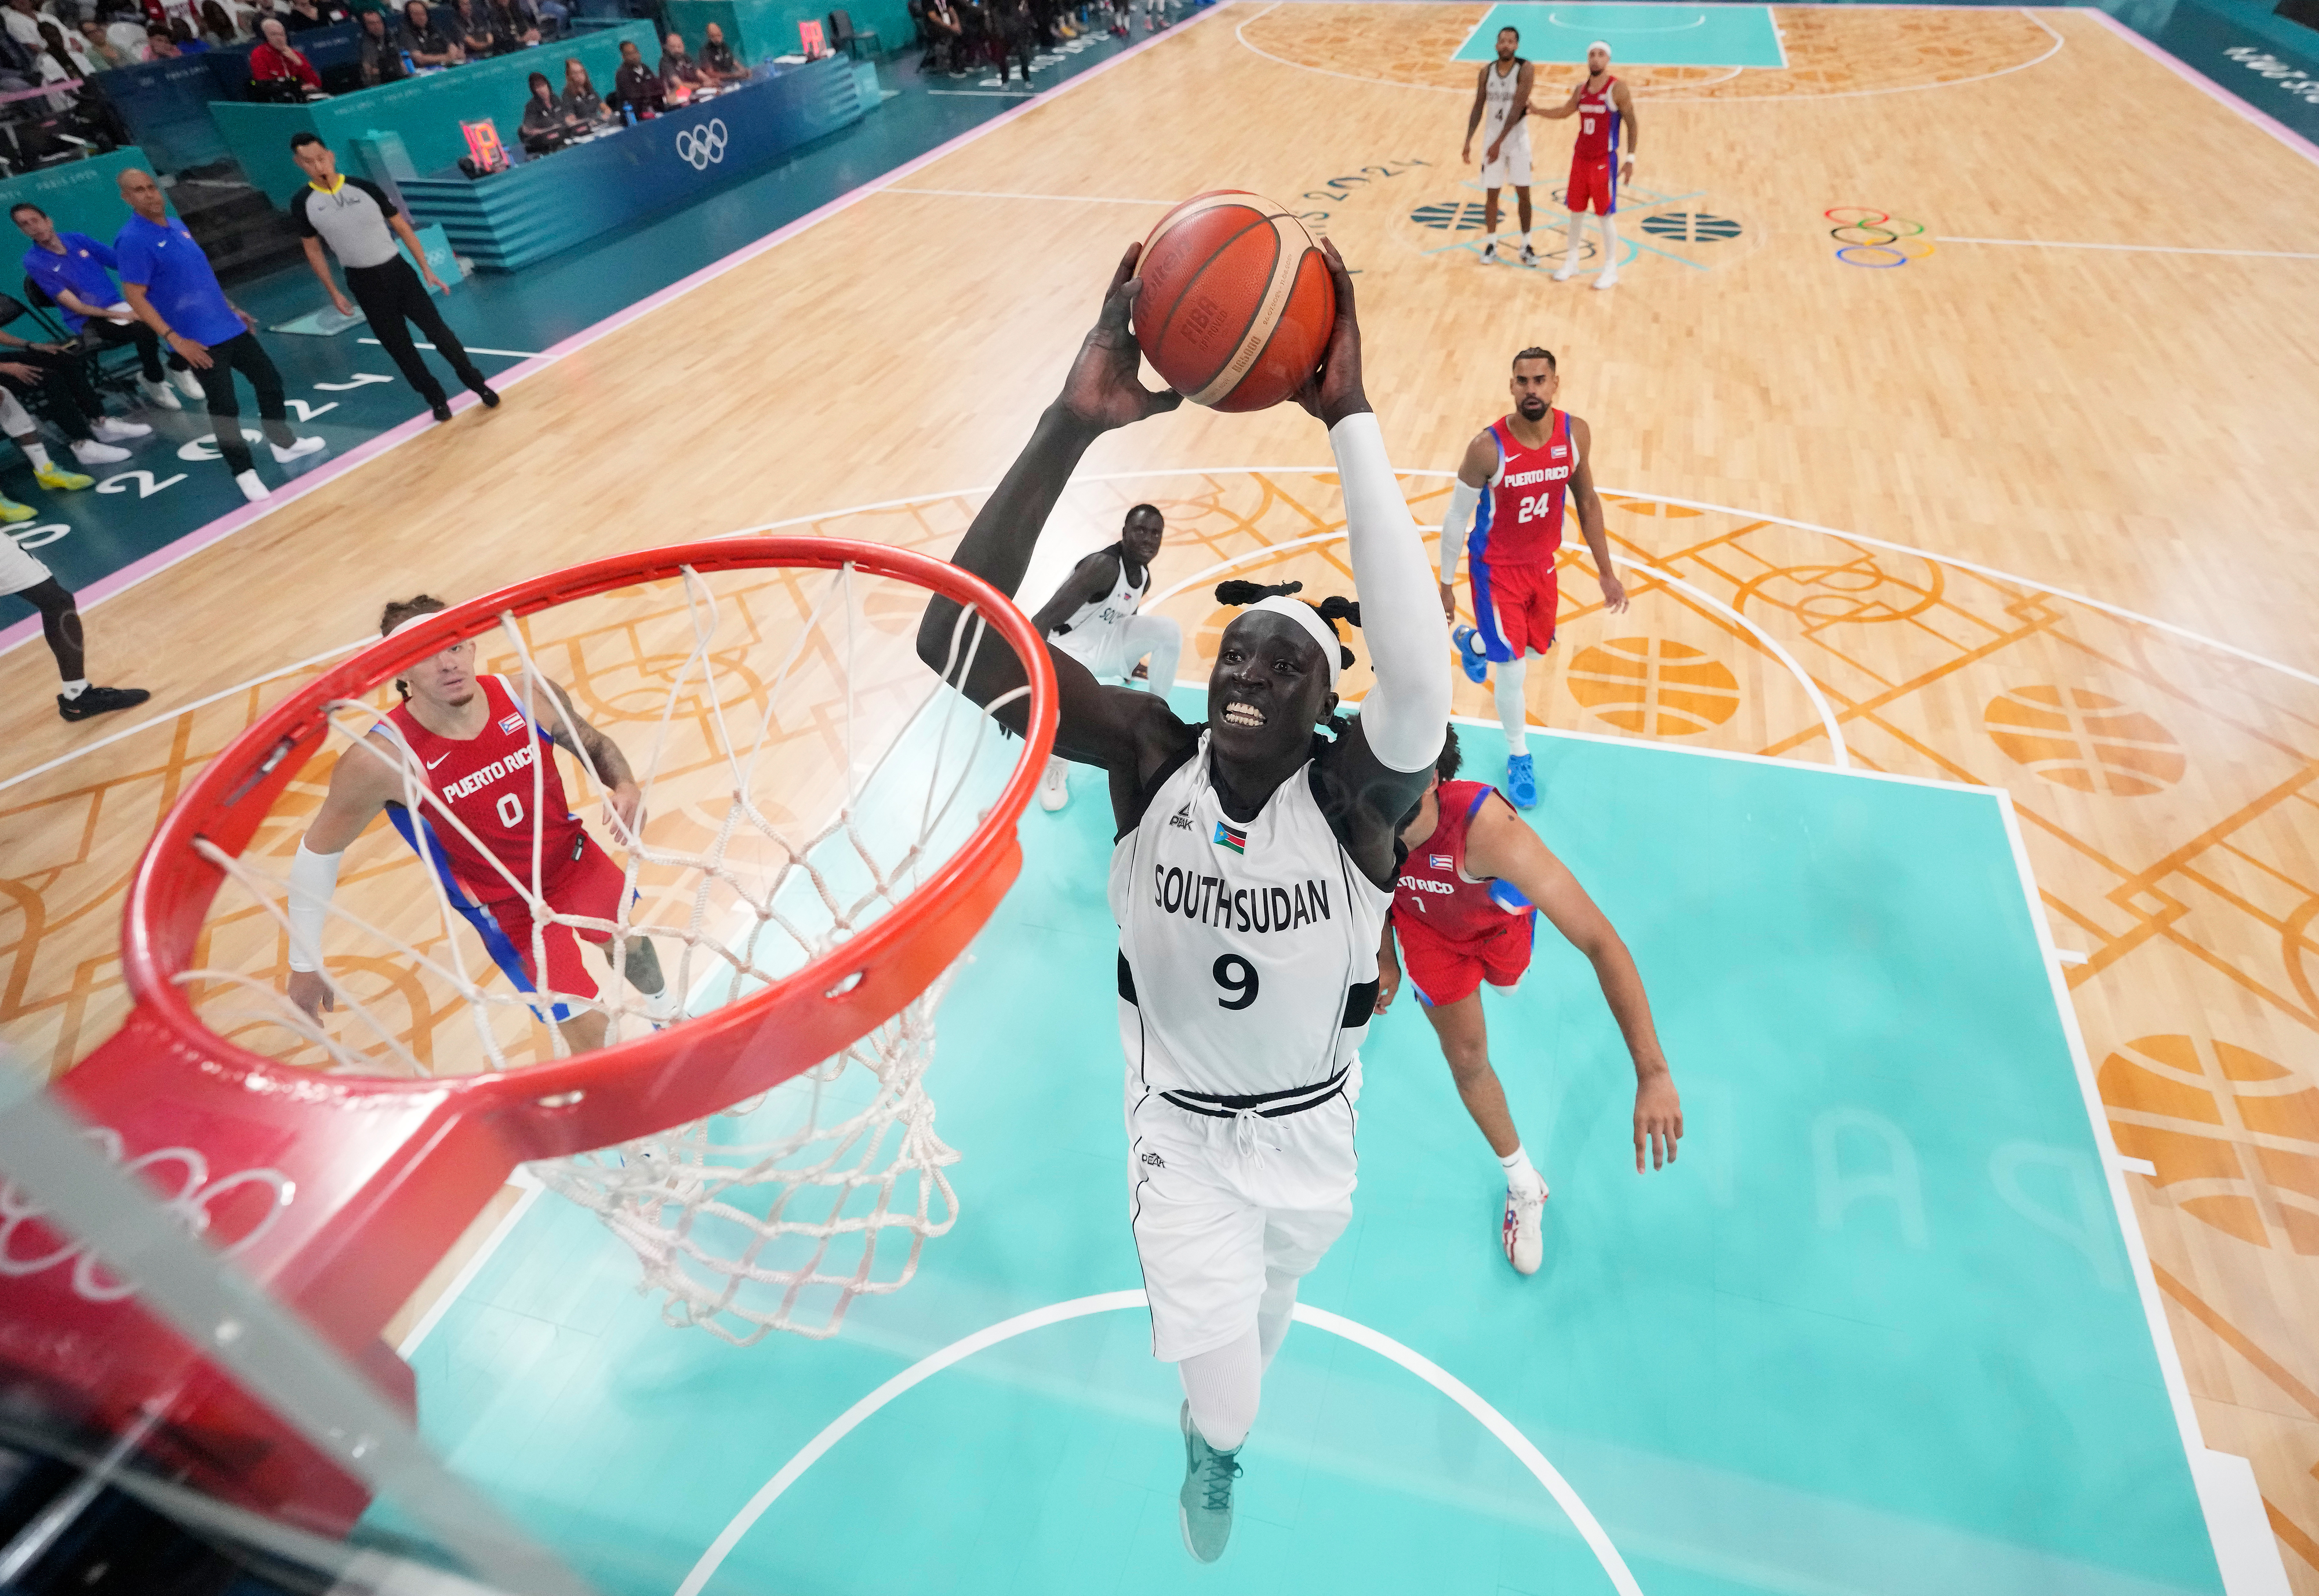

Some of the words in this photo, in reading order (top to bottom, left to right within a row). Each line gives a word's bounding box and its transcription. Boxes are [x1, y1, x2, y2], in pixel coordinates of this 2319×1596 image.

[1180, 296, 1220, 344] FIBA
[1199, 310, 1227, 351] APPROVED
[1231, 336, 1261, 373] BG5000
[1504, 470, 1544, 488] PUERTO
[1544, 466, 1569, 481] RICO
[1518, 492, 1549, 523] 24
[442, 761, 506, 804] PUERTO
[496, 792, 524, 828] 0
[1169, 815, 1194, 831] PEAK
[1155, 864, 1232, 929] SOUTH
[1234, 879, 1331, 933] SUDAN
[1412, 896, 1426, 913] 1
[1416, 879, 1455, 895] RICO
[1212, 953, 1259, 1010] 9
[1142, 1153, 1166, 1169] PEAK
